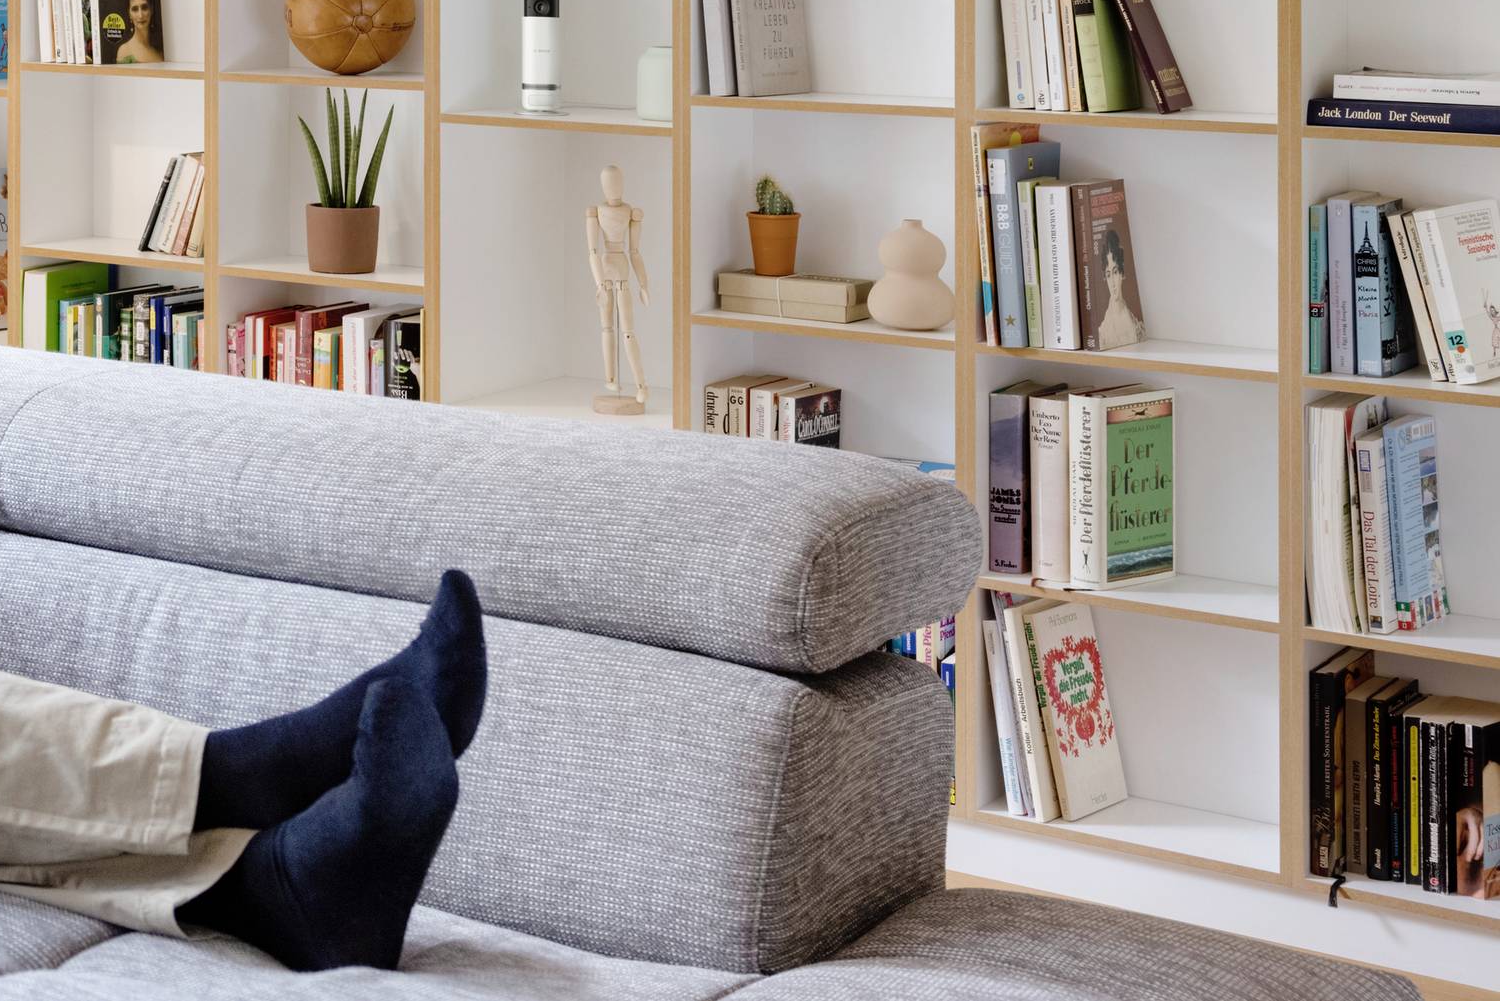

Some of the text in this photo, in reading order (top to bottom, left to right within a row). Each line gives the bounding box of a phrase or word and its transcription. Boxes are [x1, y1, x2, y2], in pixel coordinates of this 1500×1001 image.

[763, 13, 789, 27] LEBEN
[772, 30, 783, 43] ZU
[763, 44, 794, 60] FÜHREN
[1037, 93, 1046, 106] dtv
[1318, 106, 1451, 125] Jack London Der Seewolf
[996, 203, 1013, 274] B&B GUIDE
[1410, 227, 1422, 253] Tagebuch
[1457, 232, 1494, 246] Feministische
[1467, 243, 1496, 255] Soziologie
[1051, 244, 1060, 280] VATER GUSTAV
[1356, 258, 1378, 266] CHRIS
[1357, 265, 1378, 273] EWAN
[1357, 285, 1377, 293] Kleine
[1357, 295, 1378, 303] Morde
[1357, 310, 1379, 318] Paris
[1448, 335, 1465, 346] 12
[706, 391, 719, 429] drucker
[1031, 410, 1060, 421] Umberto
[1030, 426, 1061, 437] Der Name
[1033, 434, 1060, 444] der Rose
[1123, 438, 1155, 465] Der
[1079, 405, 1094, 544] Der Pferdeflüsterer
[1110, 459, 1172, 497] Pferde-
[990, 487, 1022, 497] JAMES
[990, 495, 1022, 505] JONES
[1108, 500, 1172, 532] flüsterer
[1363, 510, 1380, 609] Das Tal der Loire
[1024, 621, 1036, 642] nicht
[1030, 643, 1040, 669] Freude
[1060, 656, 1086, 674] Vergiß
[1035, 669, 1043, 683] die
[1058, 670, 1094, 692] die Freude
[1070, 688, 1090, 706] nicht
[1016, 677, 1034, 755] Koller Arbeitsbuch
[1322, 705, 1331, 783] ERSTEN SONNENSTRAHL
[1372, 724, 1381, 762] Das Zittern der
[1373, 763, 1381, 783] Martin
[1319, 846, 1328, 869] CARLSEN
